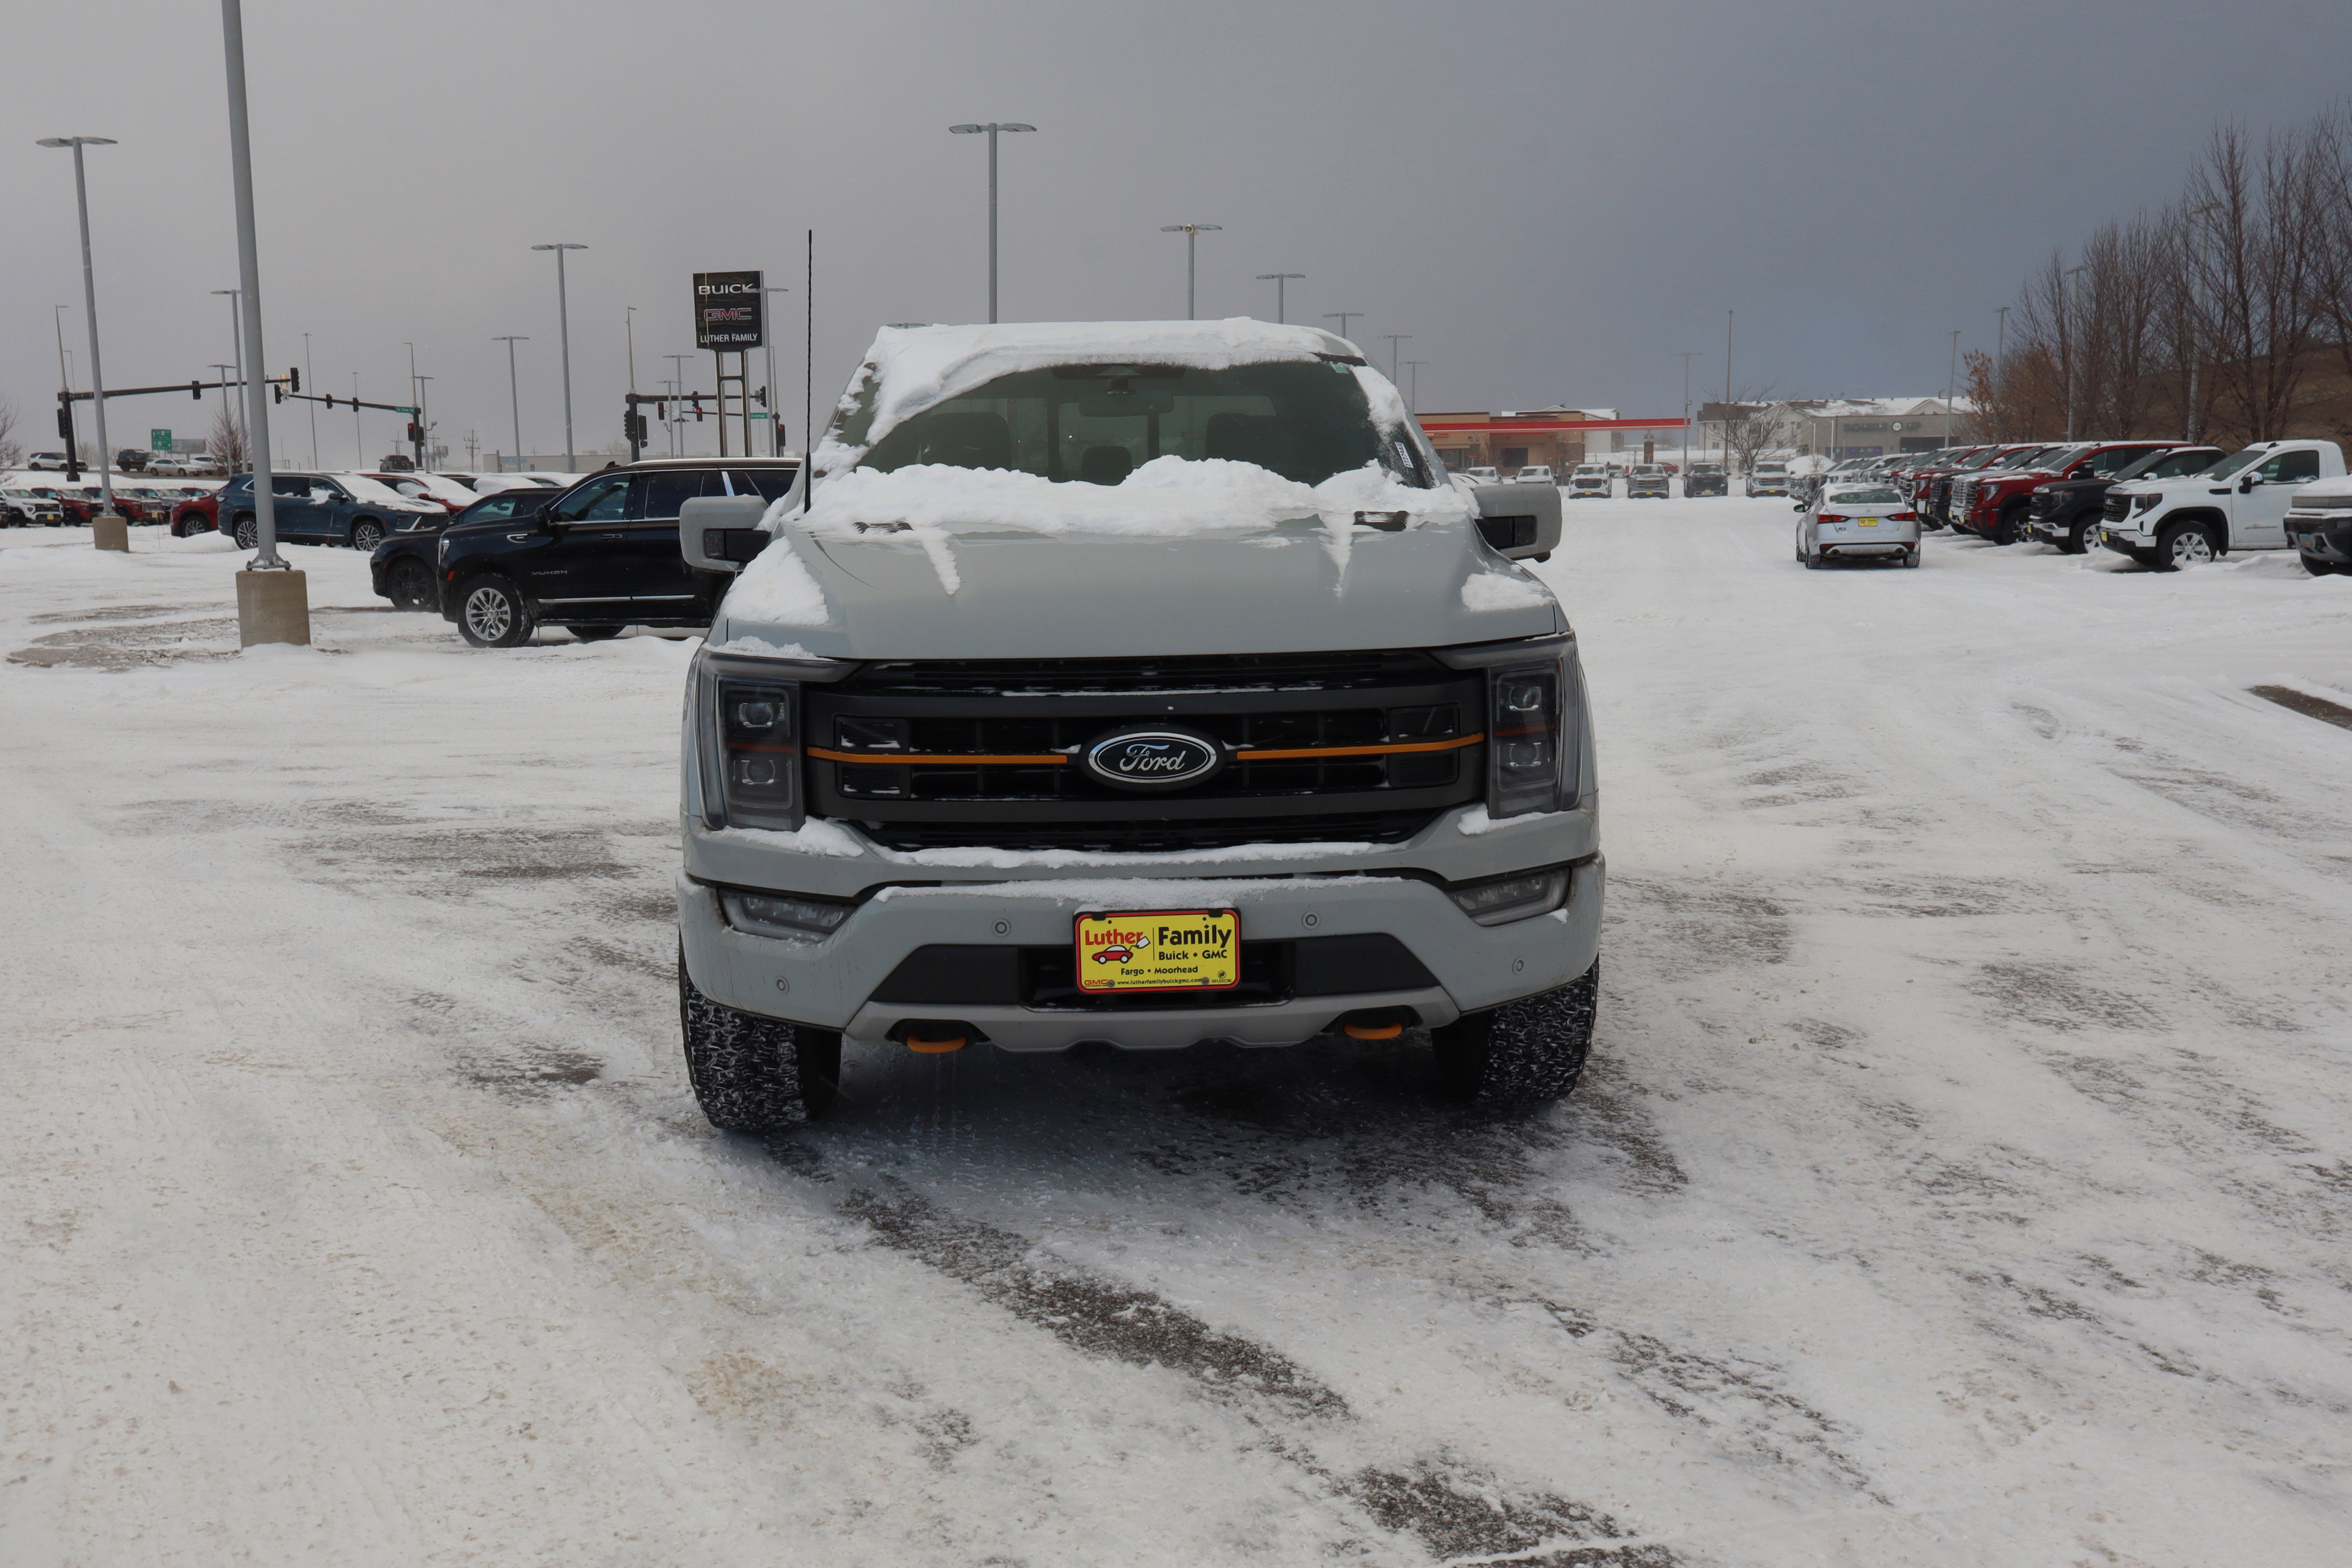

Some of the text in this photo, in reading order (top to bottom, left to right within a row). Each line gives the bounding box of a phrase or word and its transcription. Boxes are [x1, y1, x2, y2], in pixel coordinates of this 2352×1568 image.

[698, 283, 753, 295] BUICK
[704, 307, 752, 321] GMC
[700, 333, 757, 343] LUTHER FAMILY
[1119, 744, 1186, 771] Ford
[1085, 924, 1232, 948] Luther Family
[1158, 949, 1227, 960] Buick GMC
[1121, 965, 1198, 976] Fargo Moorhead
